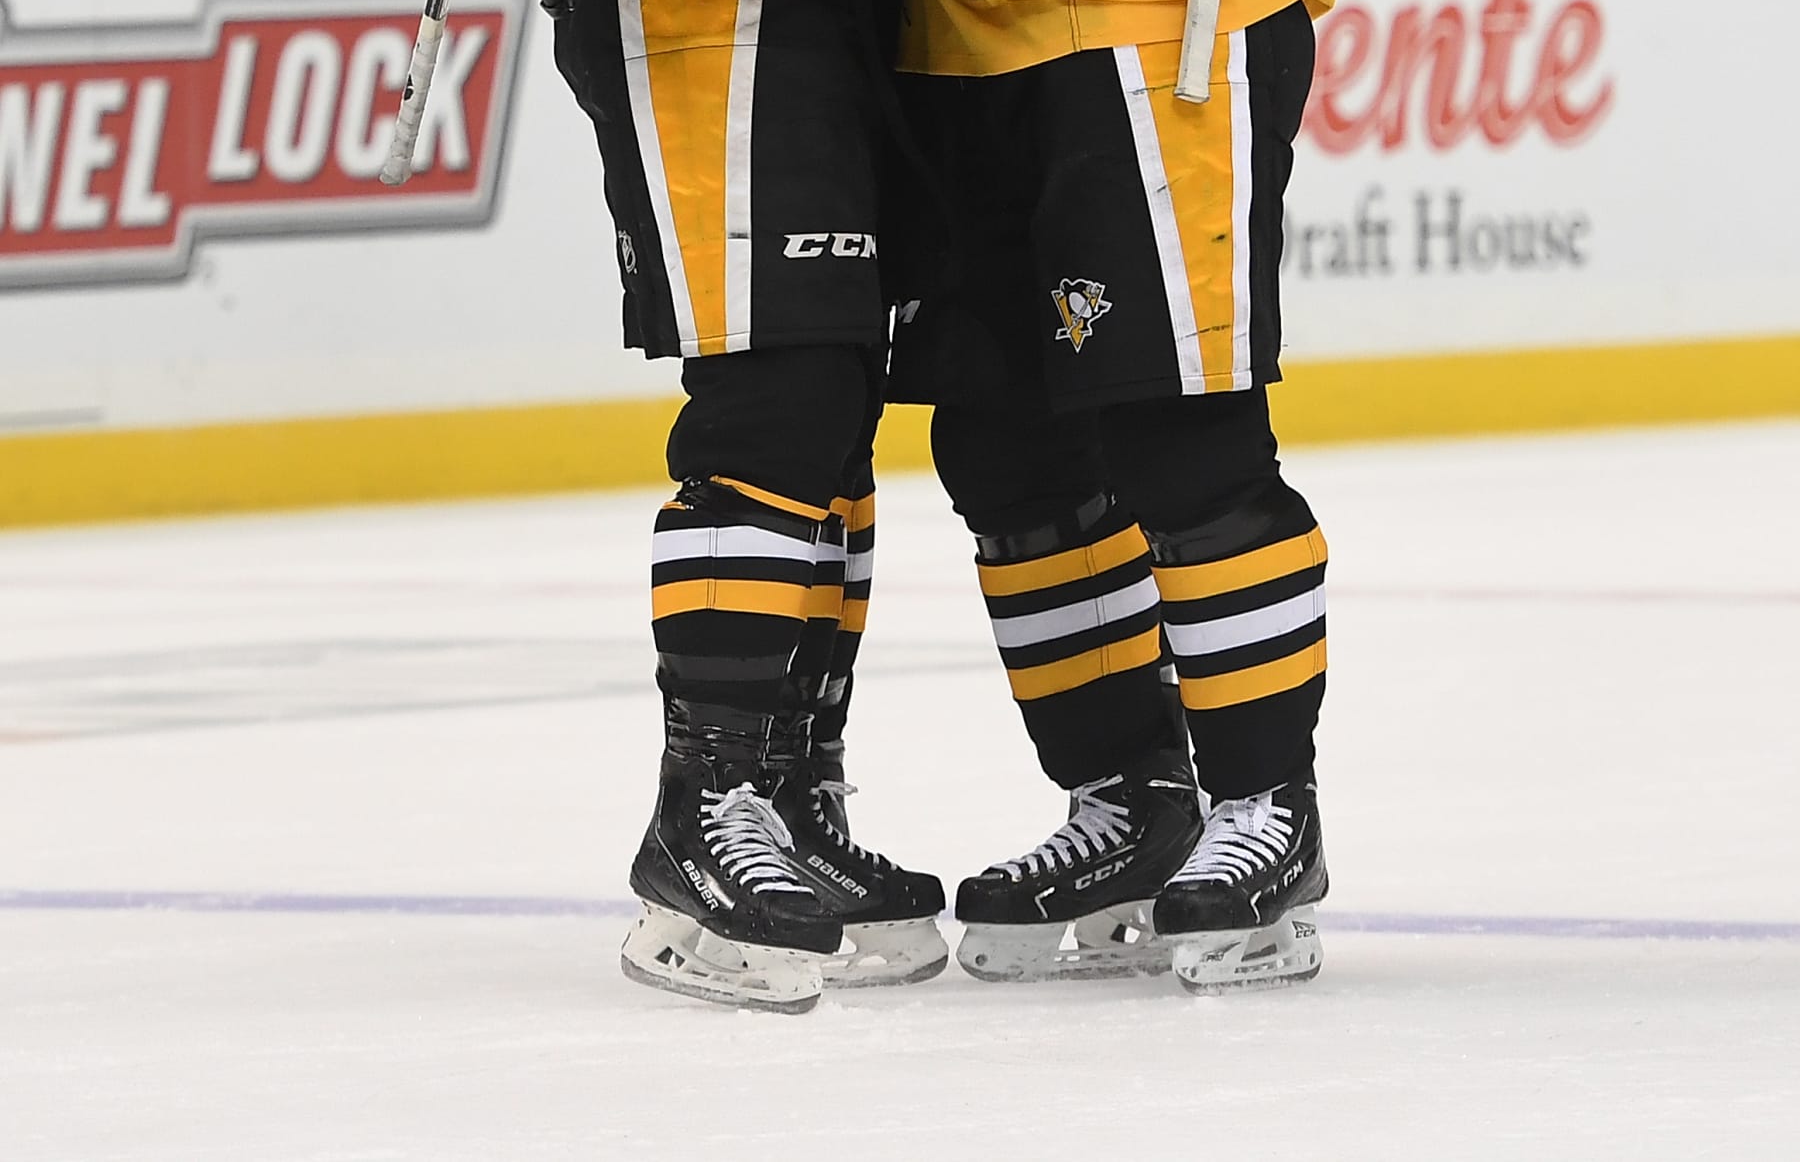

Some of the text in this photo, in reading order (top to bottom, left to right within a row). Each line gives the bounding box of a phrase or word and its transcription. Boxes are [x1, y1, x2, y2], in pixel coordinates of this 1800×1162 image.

[207, 26, 489, 184] LOCK
[1280, 186, 1592, 279] raft House
[681, 858, 720, 911] BAUER
[806, 854, 868, 900] BAUER
